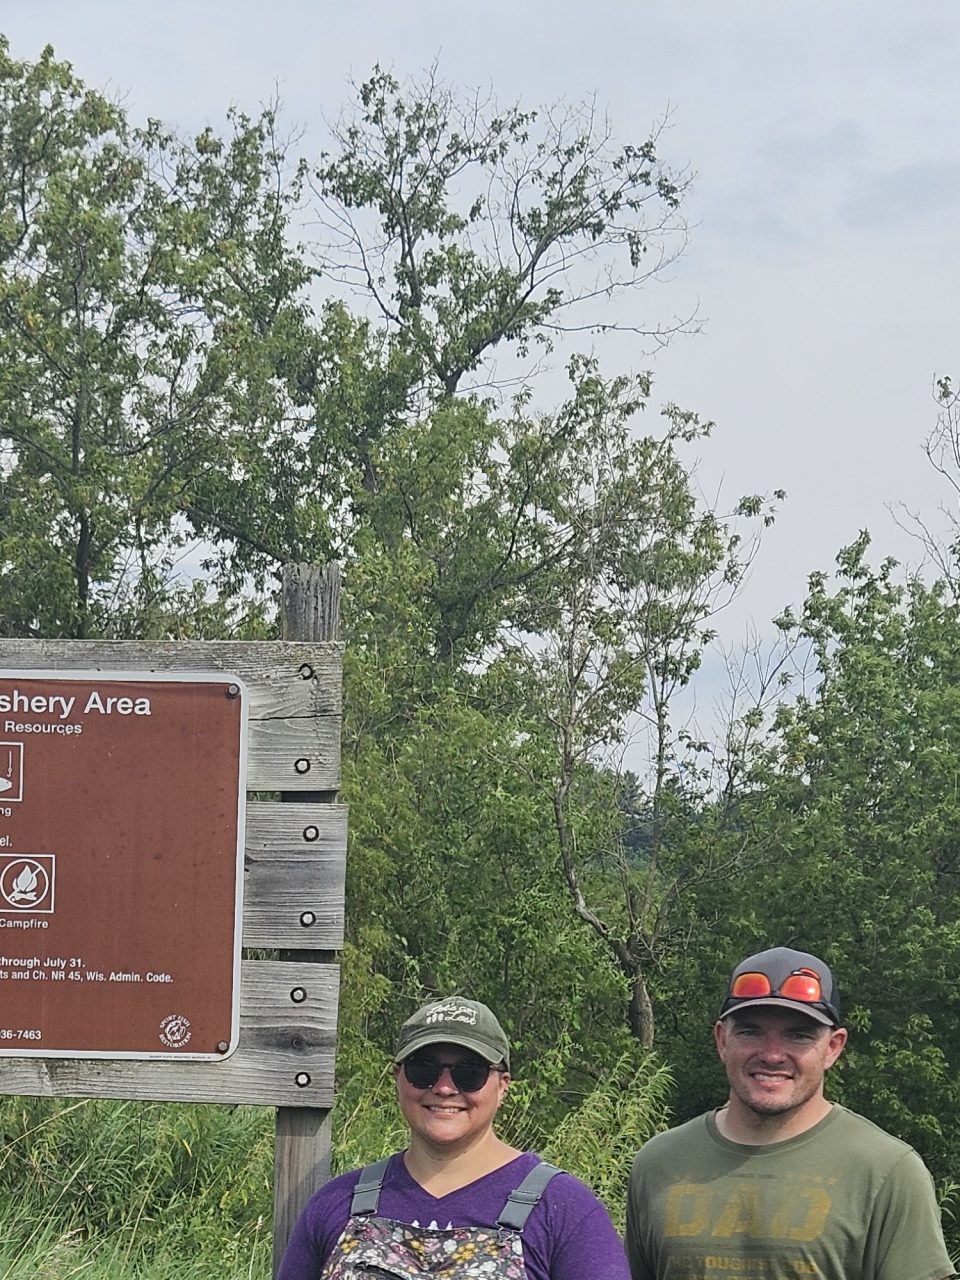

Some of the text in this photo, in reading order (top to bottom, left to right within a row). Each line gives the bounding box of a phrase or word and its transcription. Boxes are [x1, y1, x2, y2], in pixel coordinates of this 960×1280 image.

[83, 691, 152, 716] Area
[4, 720, 82, 736] Resources
[43, 957, 67, 970] July
[69, 958, 86, 968] 31.
[11, 970, 30, 980] and
[32, 969, 49, 980] Ch.
[51, 970, 66, 981] NR
[67, 970, 84, 982] 45,
[86, 971, 107, 982] Wis.
[108, 971, 144, 982] Admin.
[146, 972, 174, 983] Code.
[663, 1183, 833, 1242] DAD
